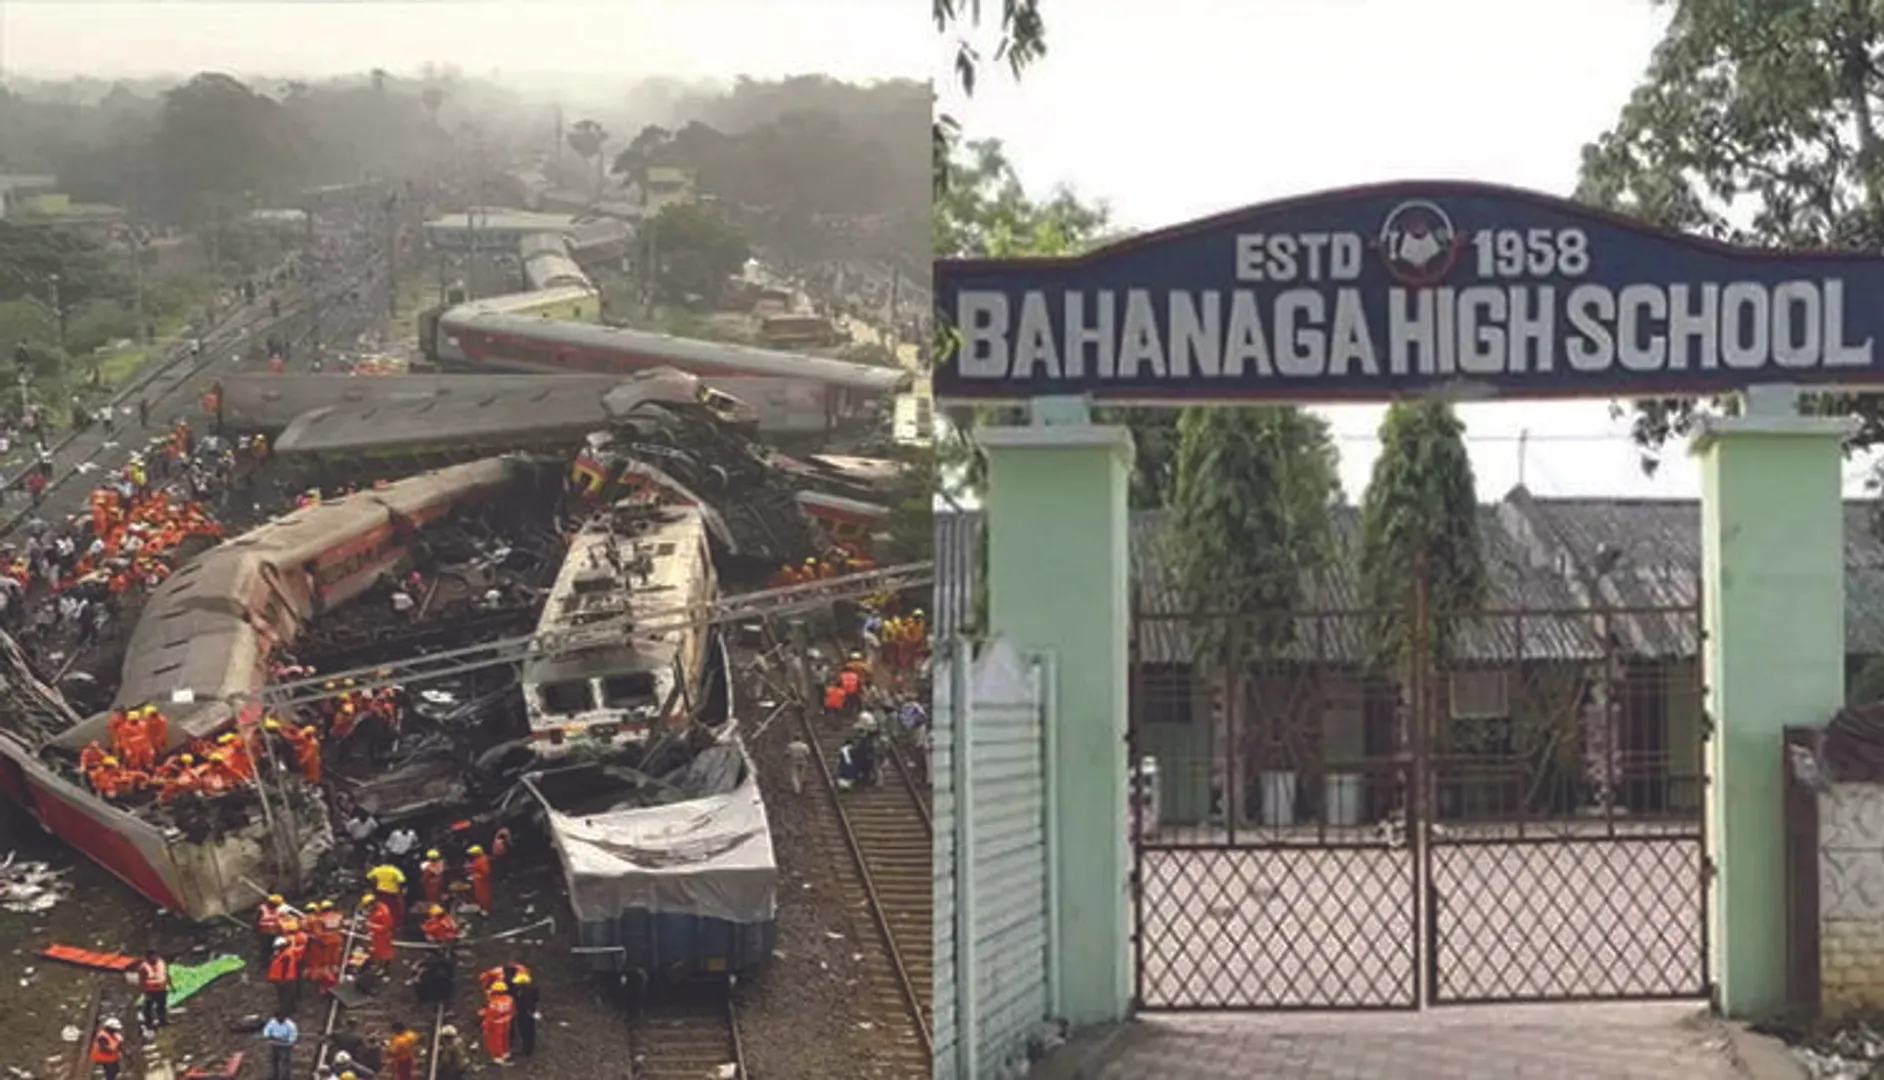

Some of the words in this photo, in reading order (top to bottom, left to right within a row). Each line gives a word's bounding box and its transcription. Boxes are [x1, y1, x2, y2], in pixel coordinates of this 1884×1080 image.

[1236, 232, 1362, 282] ESTD
[1472, 228, 1590, 277] 1958
[957, 288, 1379, 379] BAHANAGA
[1389, 284, 1555, 375] HIGH
[1565, 278, 1874, 371] SCHOOL
